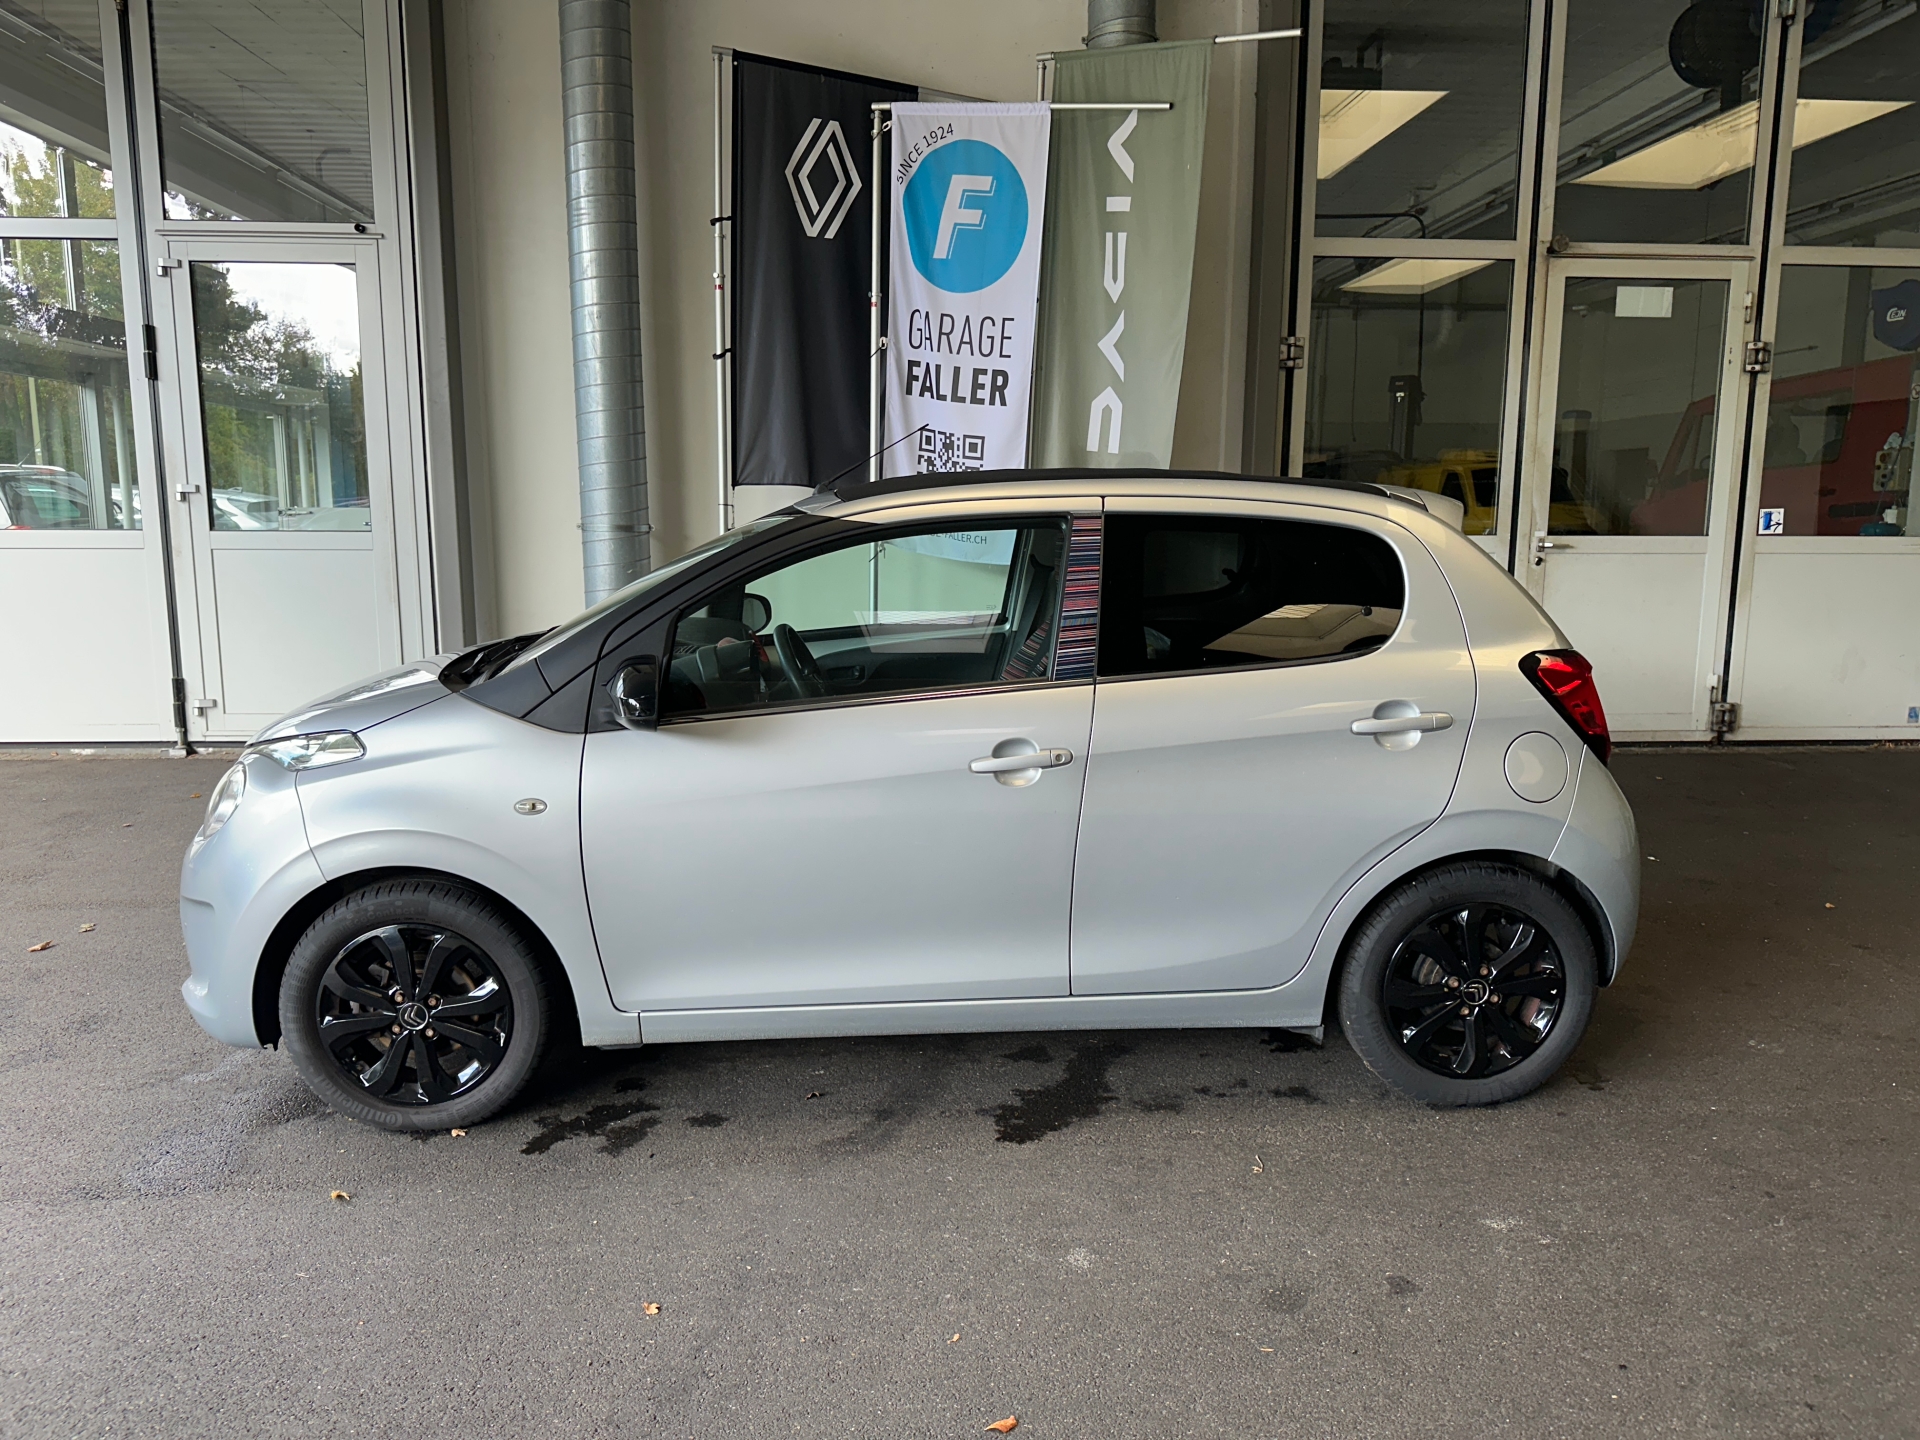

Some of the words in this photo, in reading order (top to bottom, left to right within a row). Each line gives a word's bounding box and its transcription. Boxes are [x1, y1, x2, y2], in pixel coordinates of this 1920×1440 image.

[896, 142, 924, 185] SINCE
[922, 122, 955, 148] 1924
[932, 174, 997, 260] F
[908, 308, 1015, 359] GARAGE
[905, 359, 1010, 407] FALLER
